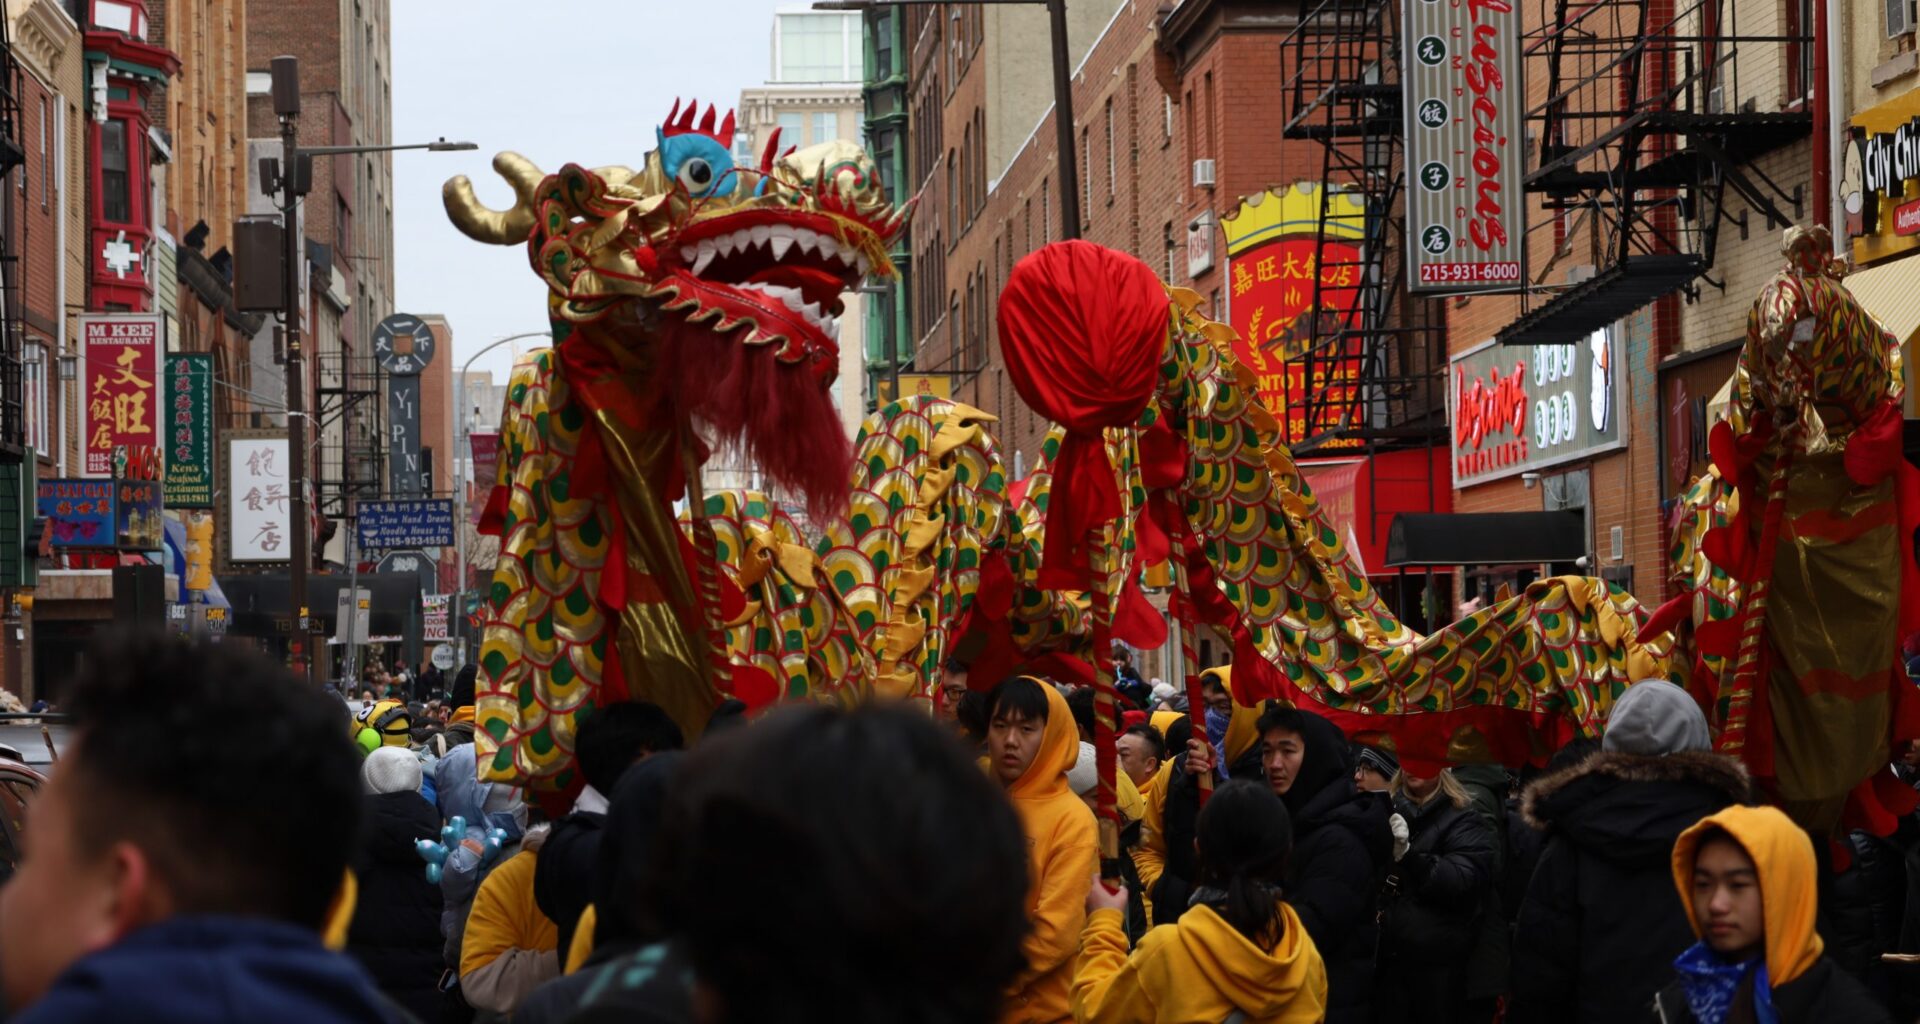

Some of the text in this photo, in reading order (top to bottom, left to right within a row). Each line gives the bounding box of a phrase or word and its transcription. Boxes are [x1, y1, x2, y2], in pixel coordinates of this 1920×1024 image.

[1422, 263, 1518, 282] 215-931-6000
[88, 324, 154, 337] M KEE
[89, 337, 152, 345] RESTAURANT
[171, 463, 199, 473] Ken's
[167, 473, 202, 484] Seafood
[402, 514, 423, 524] Hand
[380, 525, 407, 536] Noodle
[410, 525, 434, 535] House
